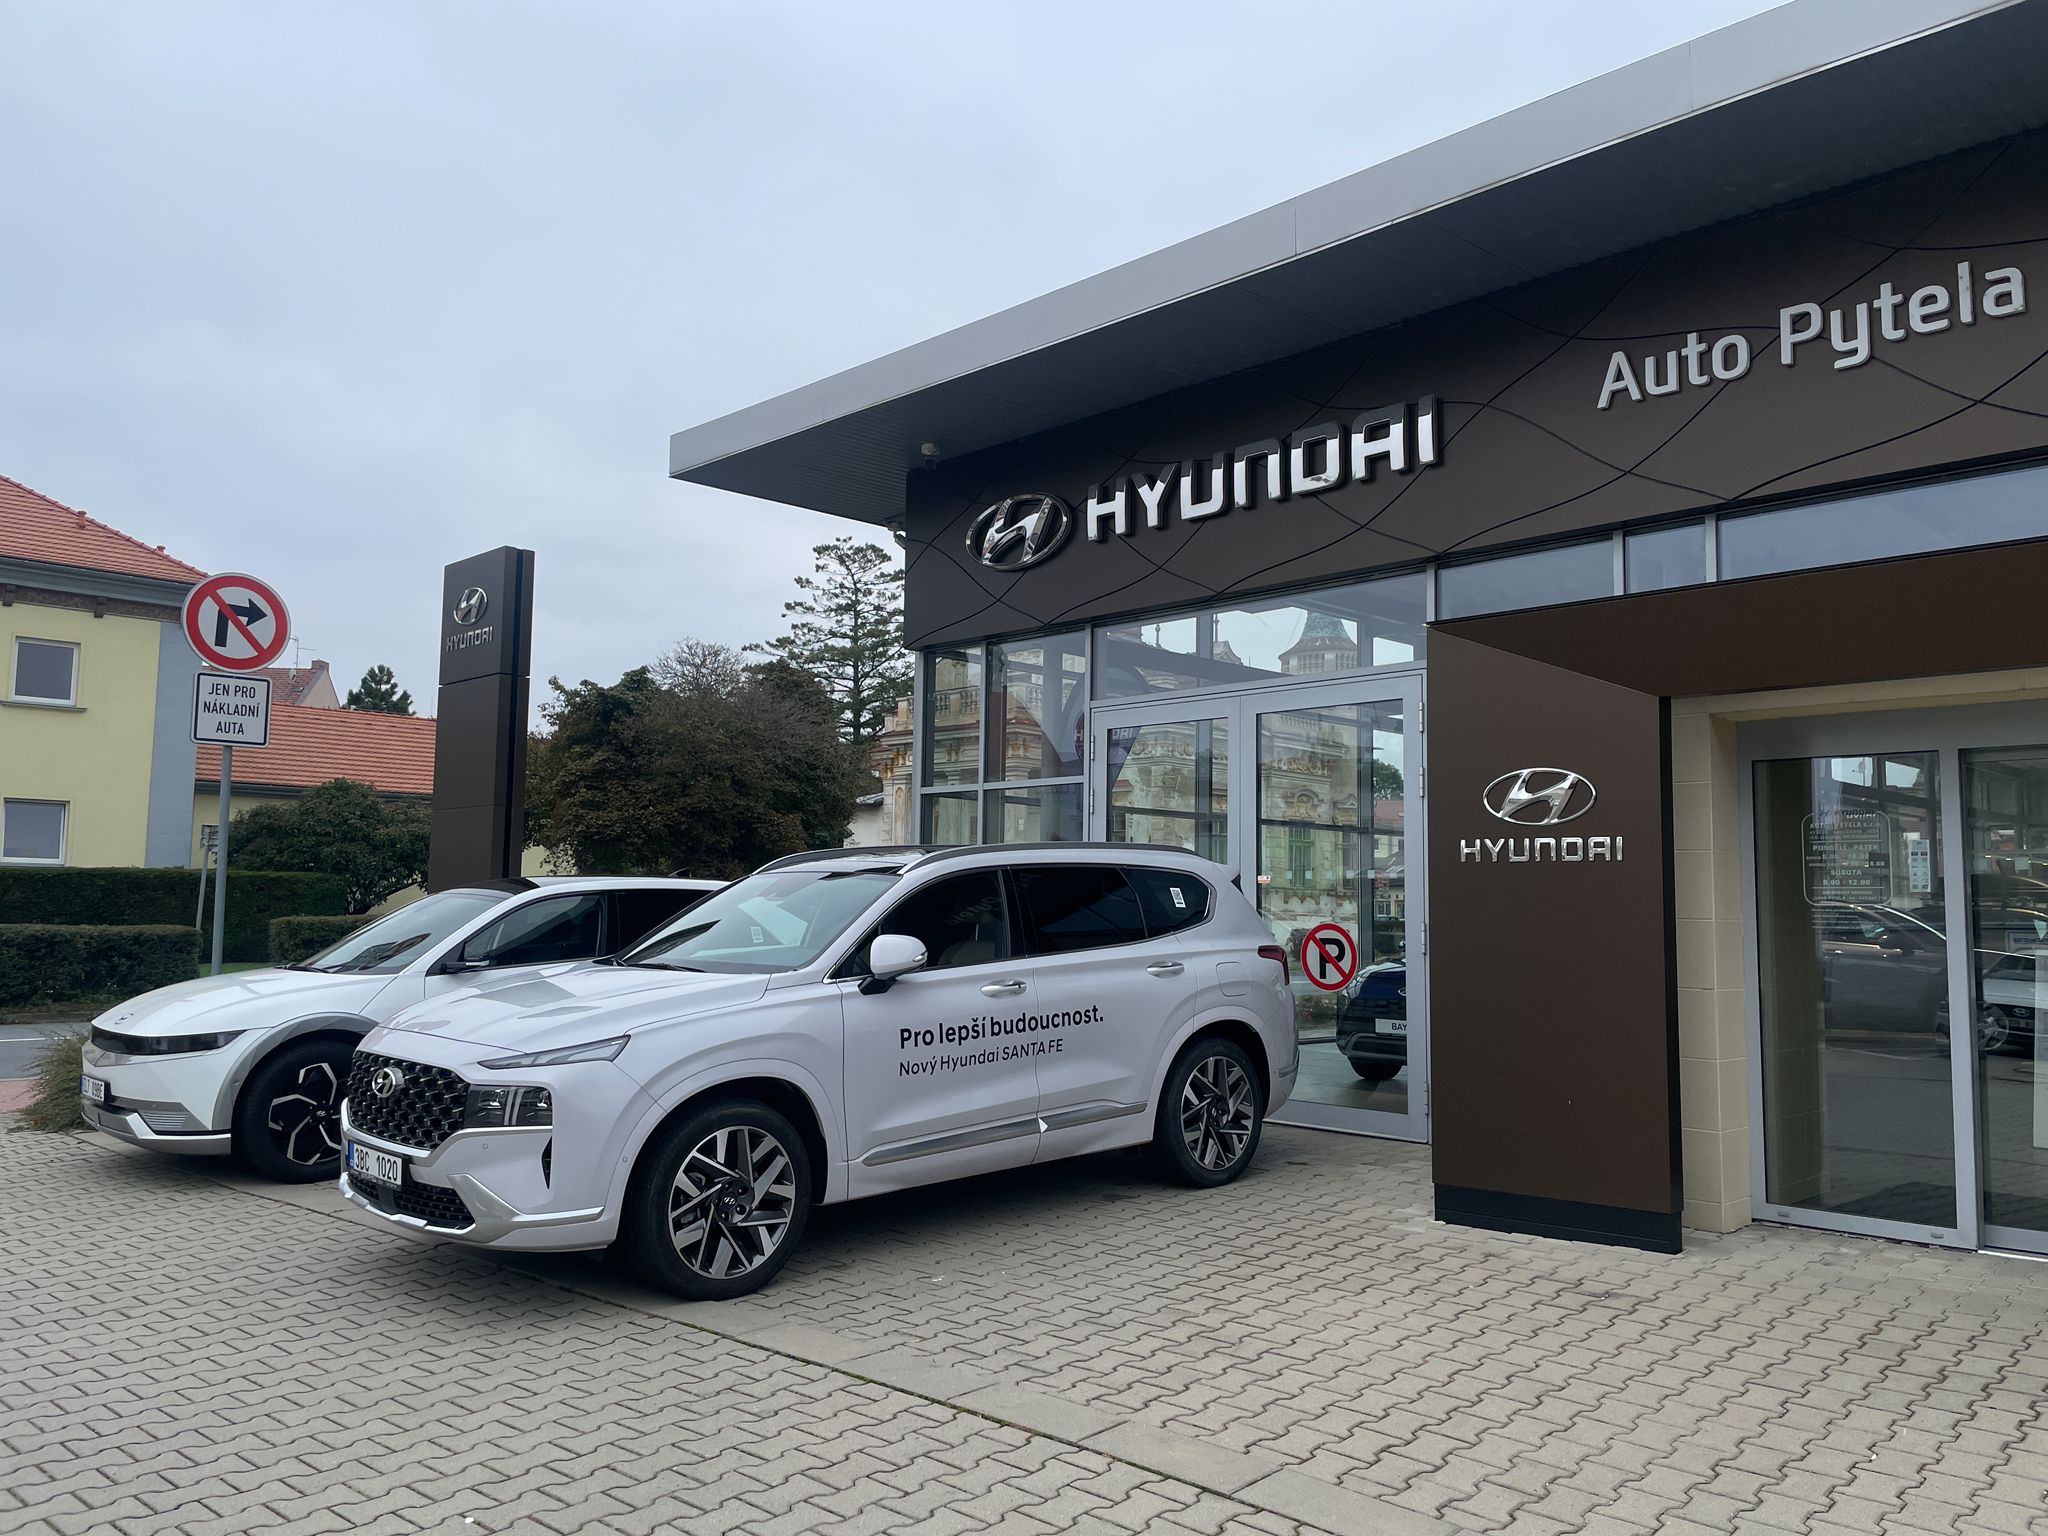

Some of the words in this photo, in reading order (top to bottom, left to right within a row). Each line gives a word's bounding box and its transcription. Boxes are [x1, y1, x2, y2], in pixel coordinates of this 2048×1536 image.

[1597, 331, 1751, 409] Auto
[1779, 261, 2026, 371] Pytela
[1086, 394, 1439, 542] HYUNDAI
[446, 626, 493, 653] HYUNDAI
[208, 682, 230, 697] JEN
[234, 684, 256, 699] PRO
[203, 699, 260, 718] NÁKLADNÍ
[215, 721, 245, 735] AUTA
[1460, 836, 1623, 863] HYUNDAI
[900, 1027, 935, 1050] Pro
[939, 1016, 986, 1046] lepší
[990, 1004, 1104, 1037] budoucnost.
[899, 1055, 937, 1077] Nový
[940, 1047, 999, 1072] Hyundai
[1001, 1041, 1046, 1061] SANTA
[1048, 1038, 1063, 1054] FE
[355, 1147, 370, 1172] 3BC
[376, 1154, 398, 1182] 1020
